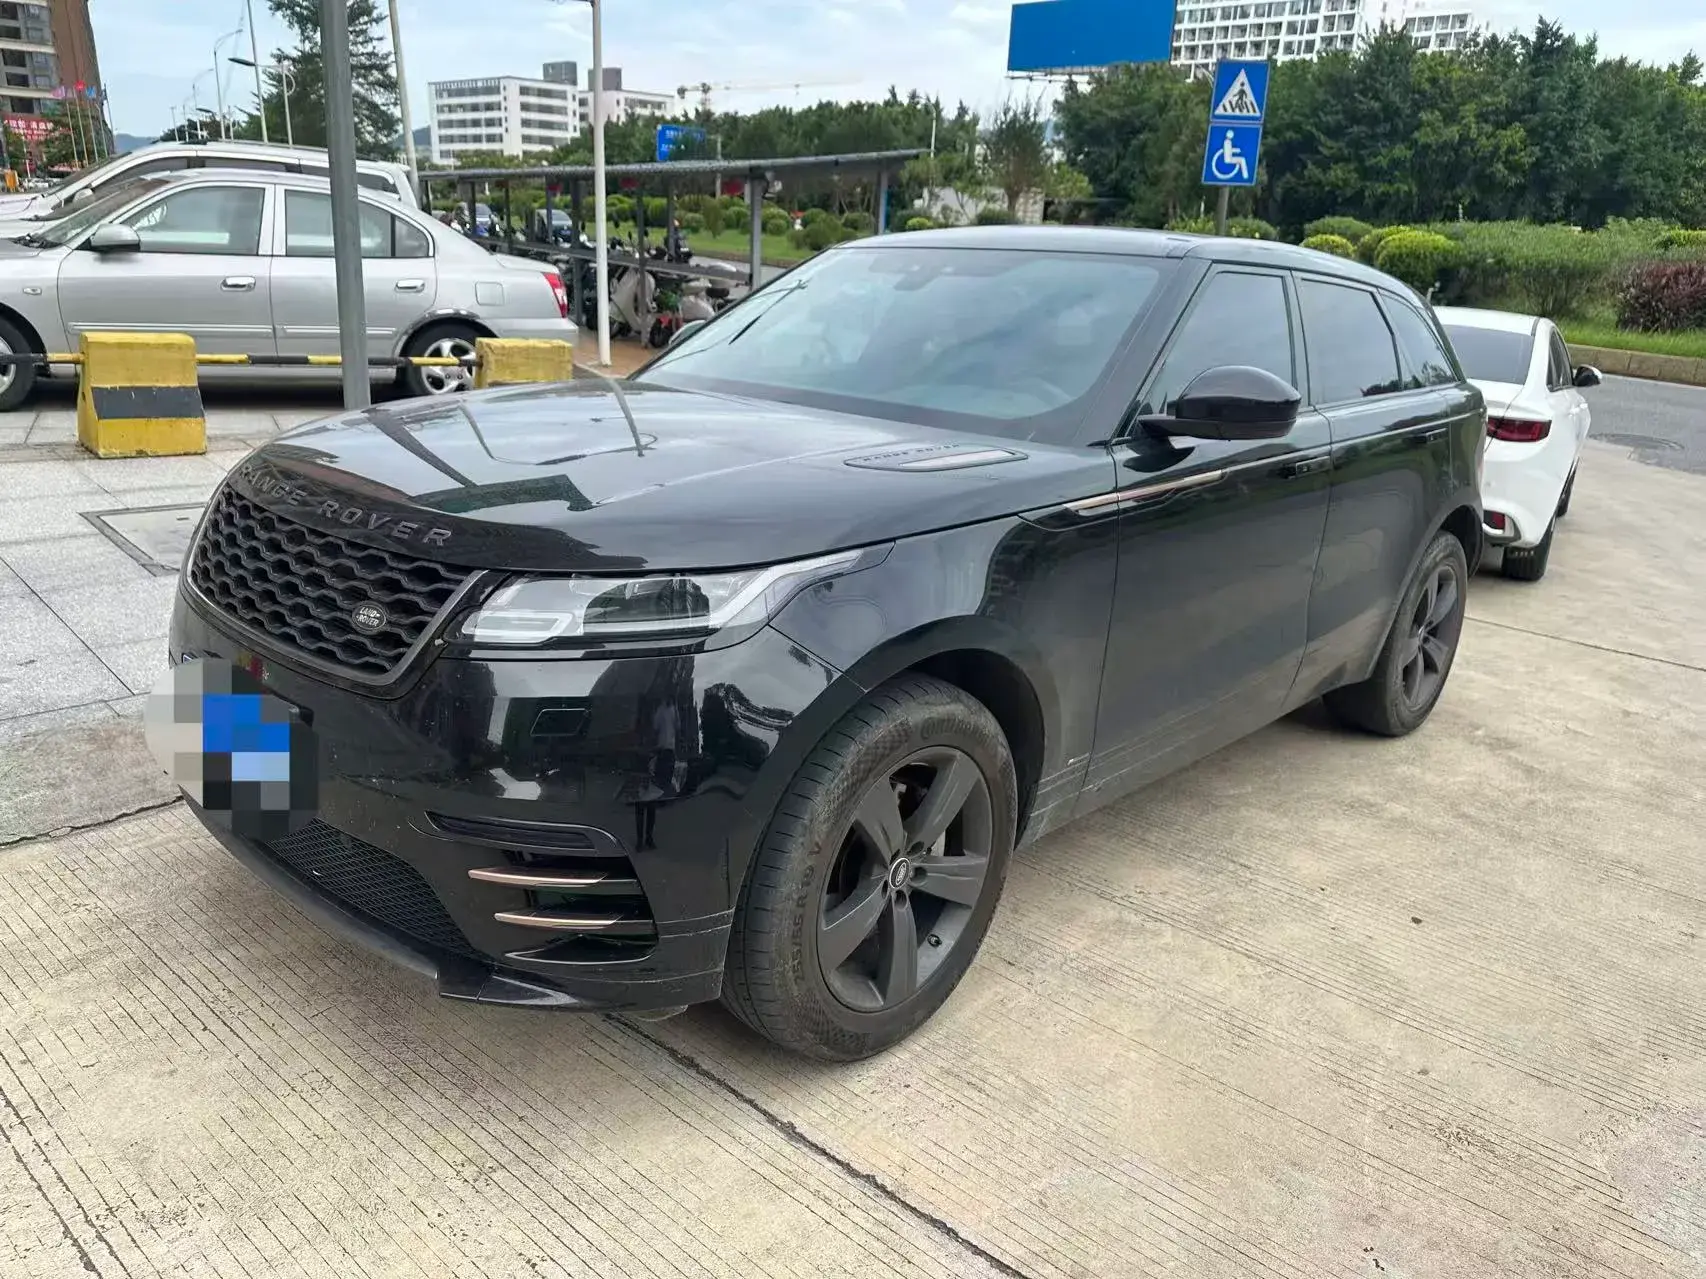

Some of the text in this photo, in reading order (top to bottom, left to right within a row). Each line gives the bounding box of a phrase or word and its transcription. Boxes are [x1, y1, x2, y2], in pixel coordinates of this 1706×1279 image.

[239, 462, 452, 547] RANGE ROVER
[357, 614, 379, 627] ROVER
